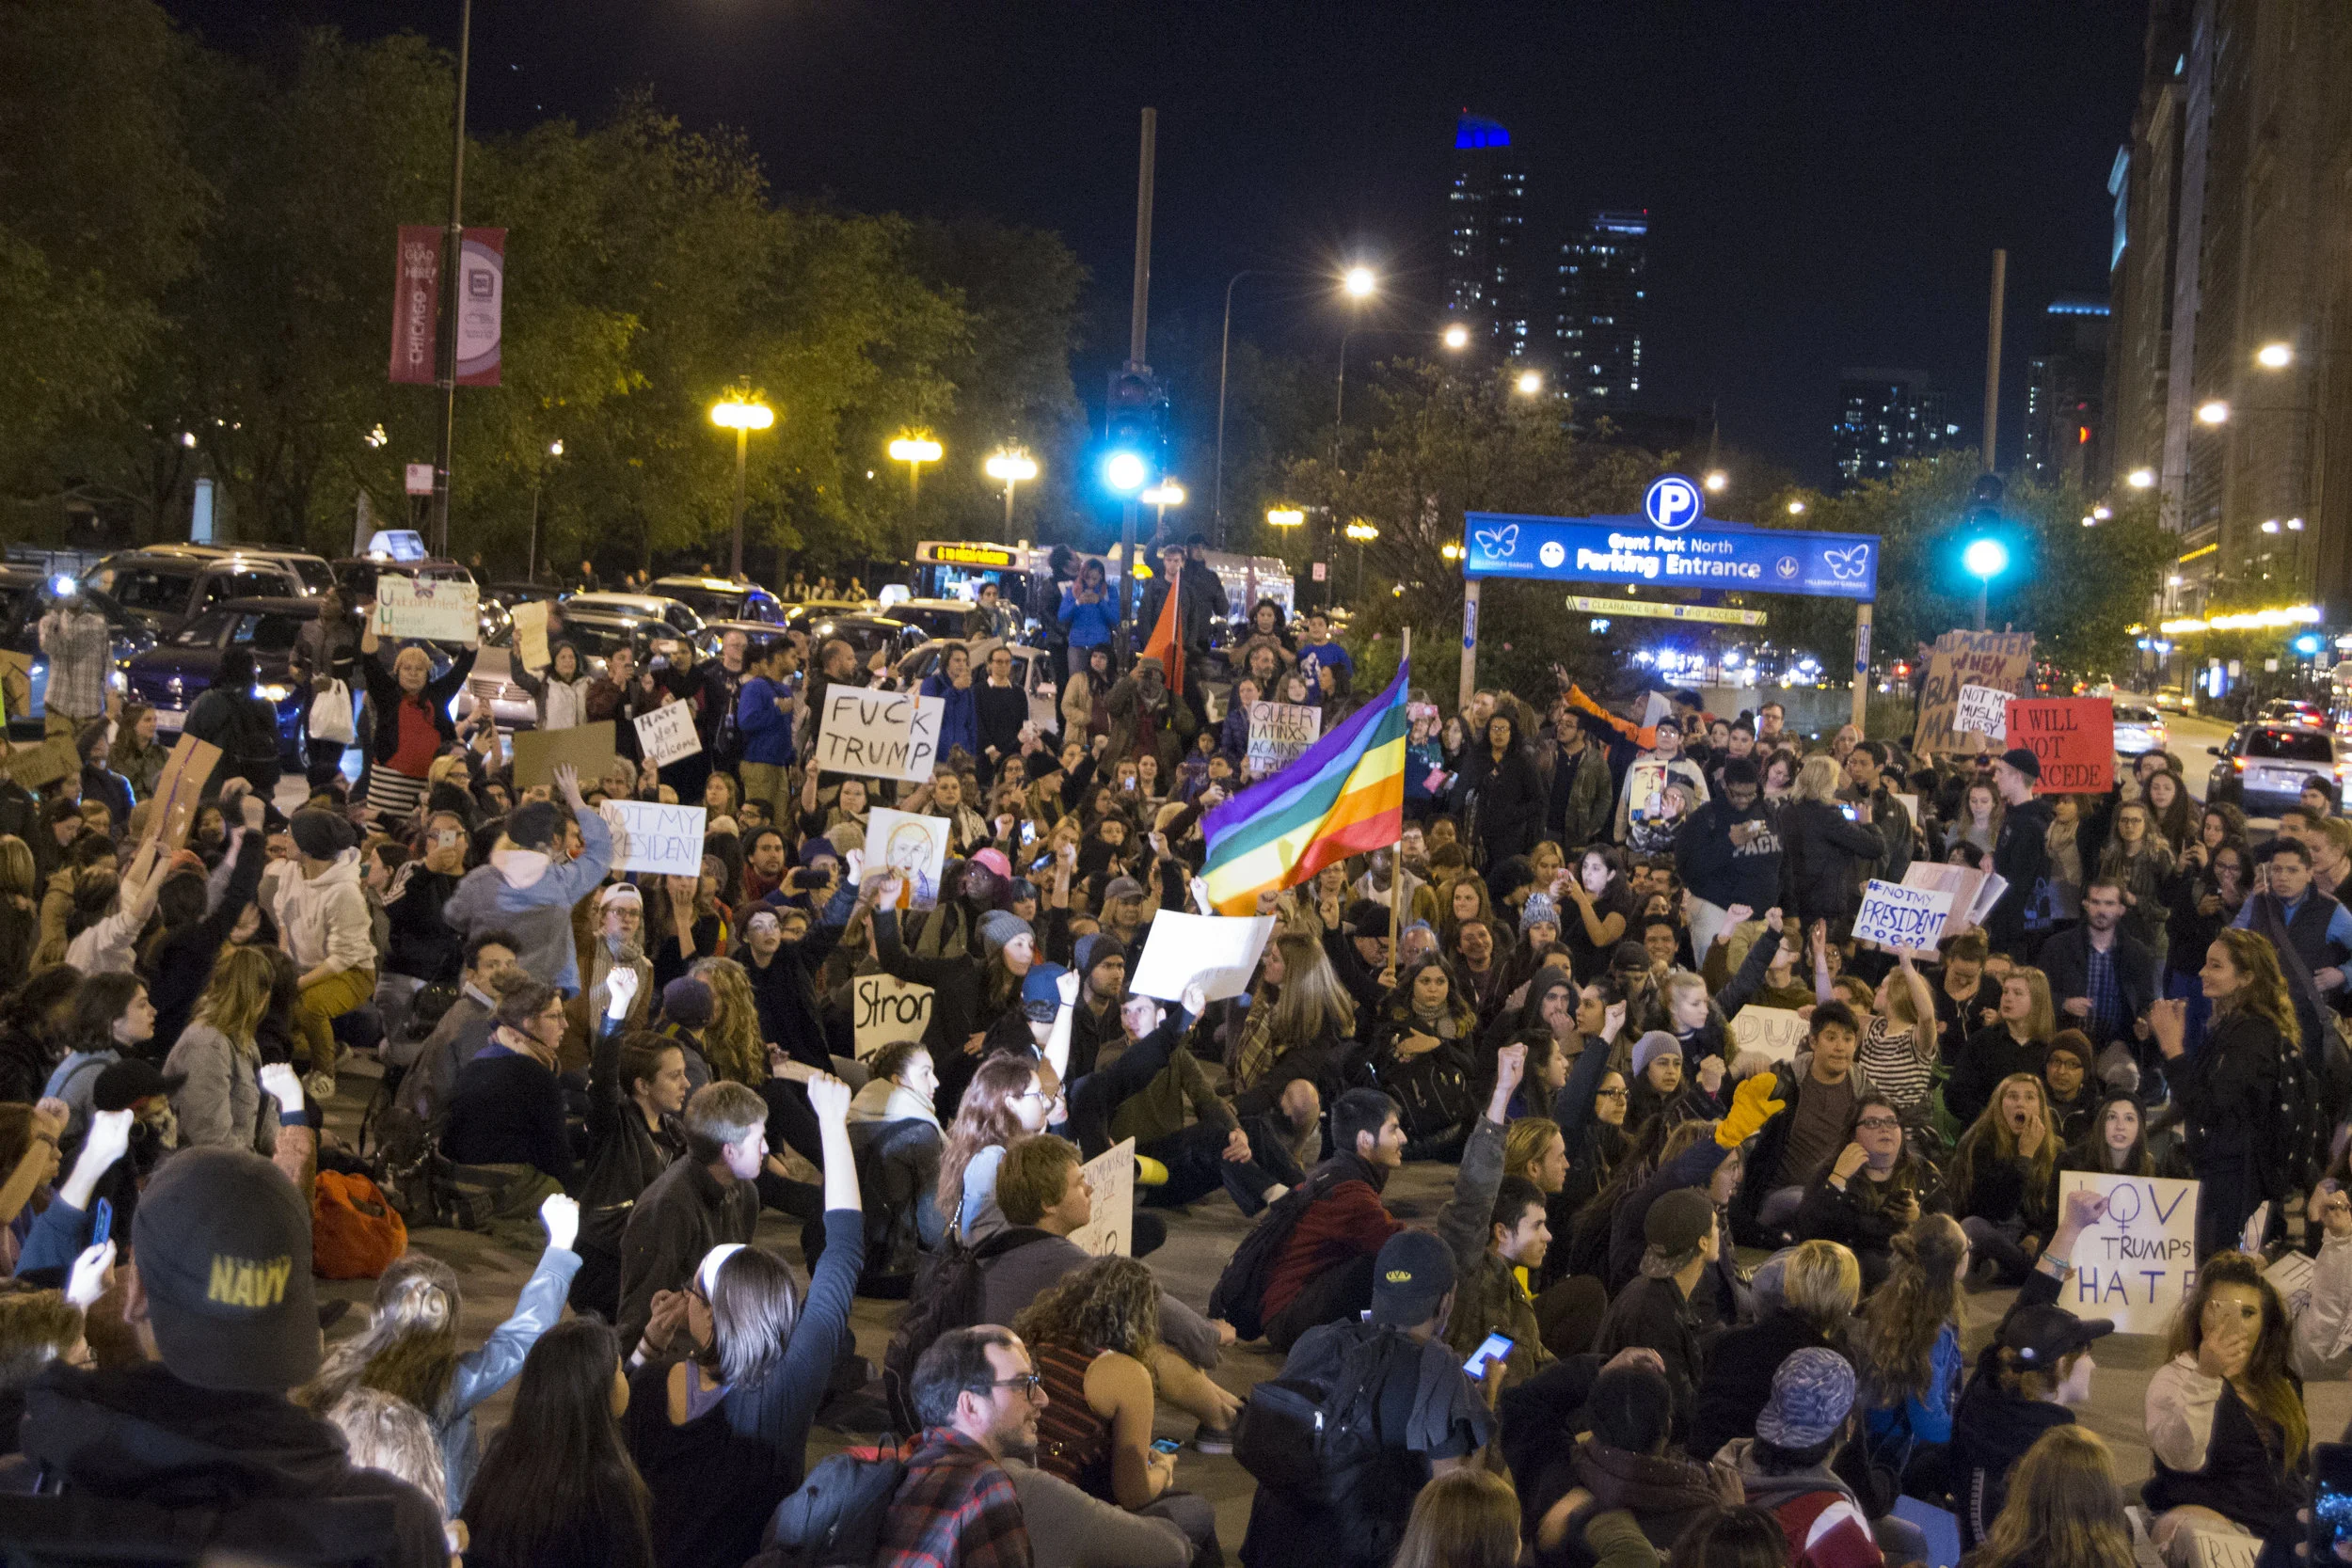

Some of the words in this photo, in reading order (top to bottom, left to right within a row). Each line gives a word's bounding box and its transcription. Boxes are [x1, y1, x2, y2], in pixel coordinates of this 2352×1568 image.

[1659, 484, 1691, 524] P
[1608, 532, 1651, 551] Grant
[1654, 535, 1686, 552] Park
[1691, 539, 1733, 554] North
[1577, 548, 1660, 579] Parking
[1666, 553, 1762, 579] Entrance
[1591, 600, 1643, 613] CLEARANCE
[1706, 610, 1741, 622] ACCESS
[1951, 651, 2008, 677] WHEN
[1962, 688, 1990, 704] NOT
[833, 695, 932, 736] FUCK
[1253, 703, 1314, 728] QUEER
[1961, 704, 2005, 724] MUSLIM
[2012, 708, 2019, 731] I
[2028, 708, 2078, 731] WILL
[1963, 718, 1999, 736] PUSSY
[826, 732, 932, 770] TRUMP
[1250, 739, 1313, 755] AGAINST
[1248, 755, 1295, 770] TRUM
[2034, 764, 2101, 787] NCEDE
[603, 805, 653, 830] NOT
[658, 808, 701, 835] MY
[610, 831, 703, 866] RESIDENT
[1861, 898, 1947, 936] PRESIDENT
[856, 980, 935, 1028] Stron
[2100, 1235, 2192, 1261] TRUMPS
[208, 1253, 292, 1308] NAVY
